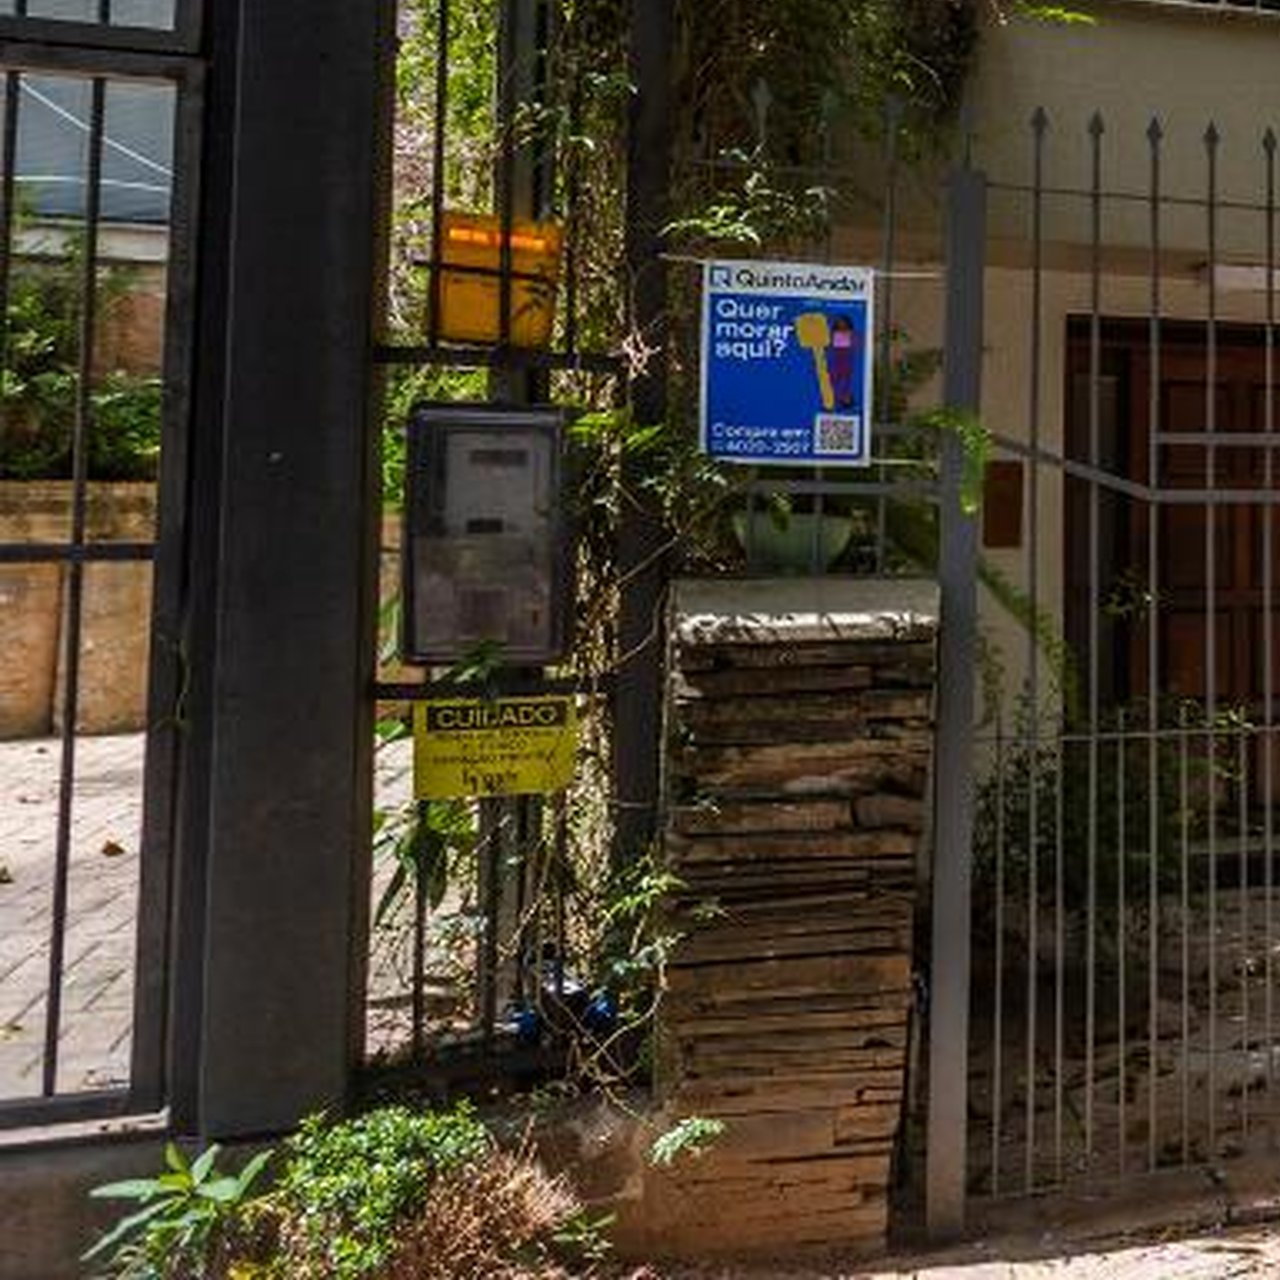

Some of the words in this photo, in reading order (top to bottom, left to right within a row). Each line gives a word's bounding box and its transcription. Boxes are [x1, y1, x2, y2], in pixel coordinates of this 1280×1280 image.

[736, 269, 865, 291] QuintoAndar
[716, 298, 784, 319] Quer
[715, 321, 795, 338] morar
[715, 339, 787, 360] aqui?
